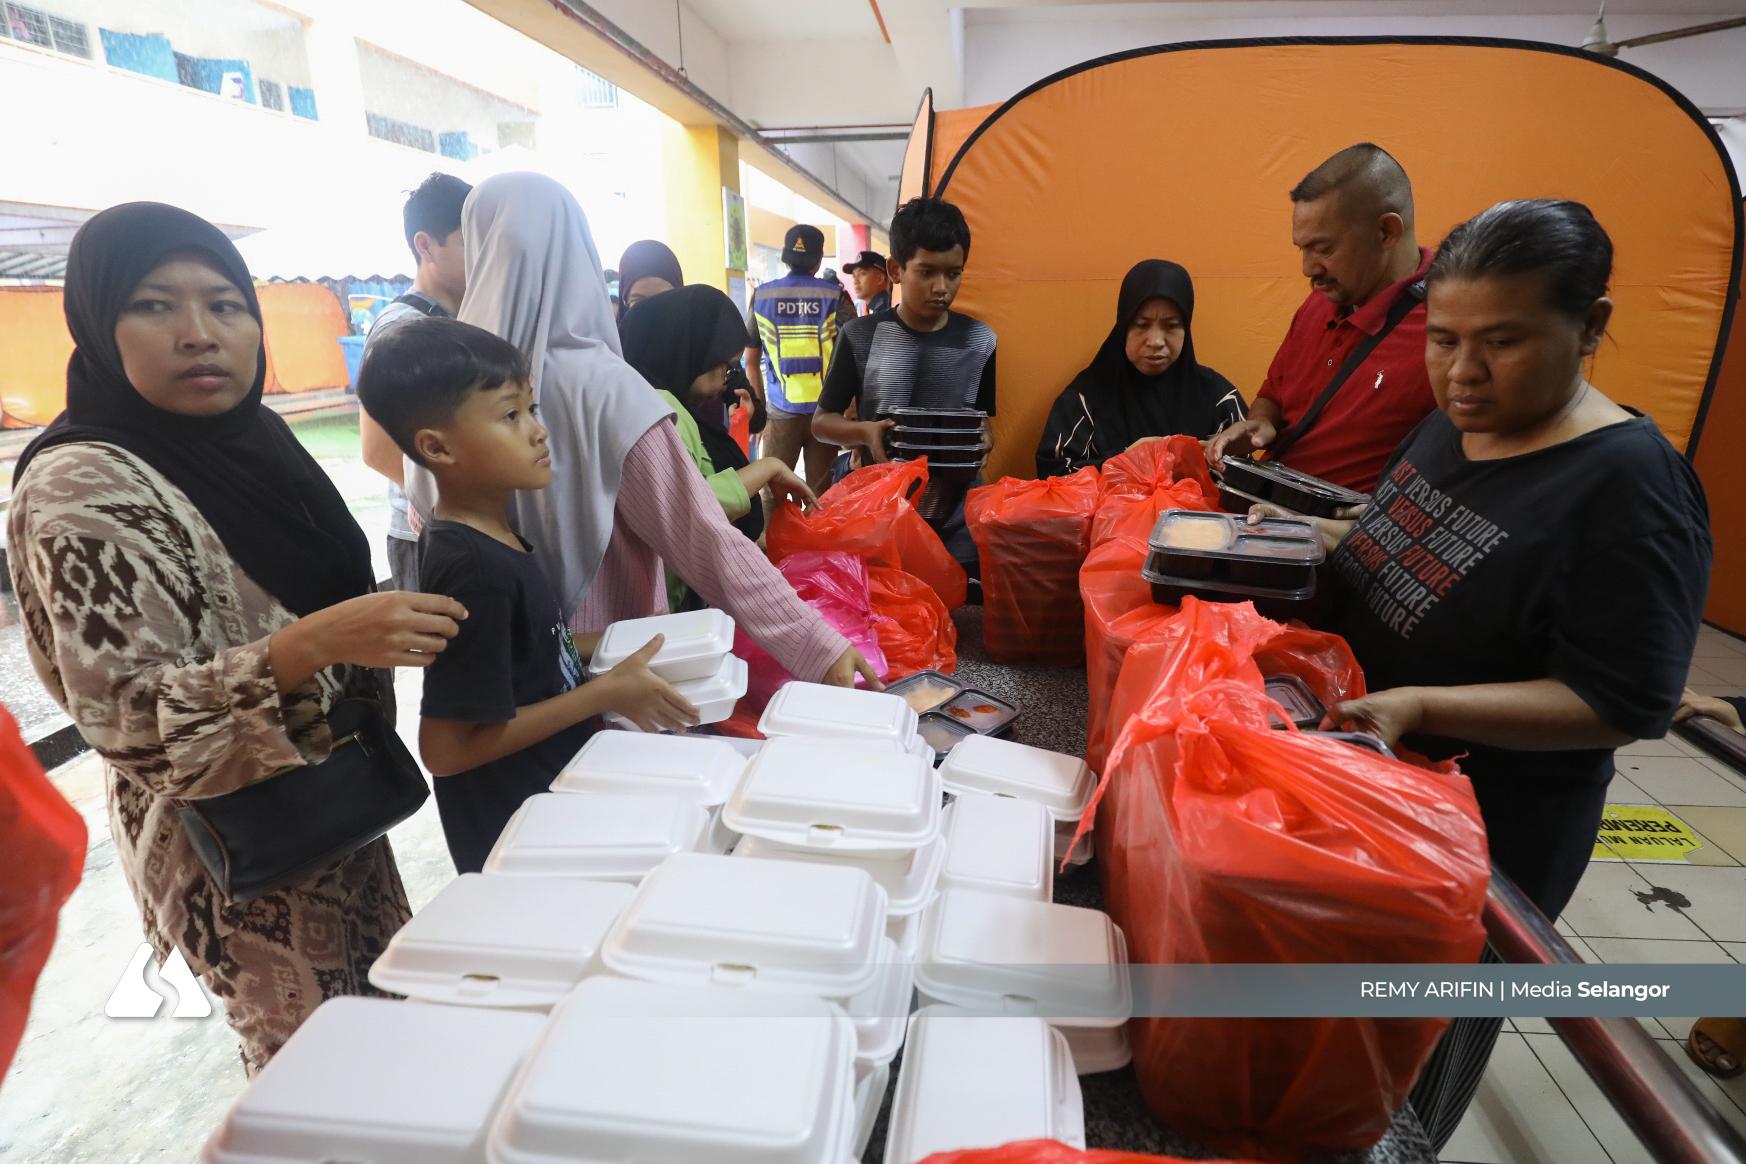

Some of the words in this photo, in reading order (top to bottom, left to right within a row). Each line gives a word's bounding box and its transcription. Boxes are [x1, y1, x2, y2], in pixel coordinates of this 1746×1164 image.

[777, 301, 820, 315] PDTKS
[1422, 526, 1484, 576] FUTURE
[1444, 505, 1510, 553] FUTURE
[1367, 513, 1413, 555] VERSUS
[1397, 544, 1462, 598] FUTURE
[1365, 581, 1420, 640] FUTURE
[1377, 561, 1440, 618] FUTURE
[1599, 819, 1682, 833] PEREMP
[1628, 836, 1696, 847] LALUAN
